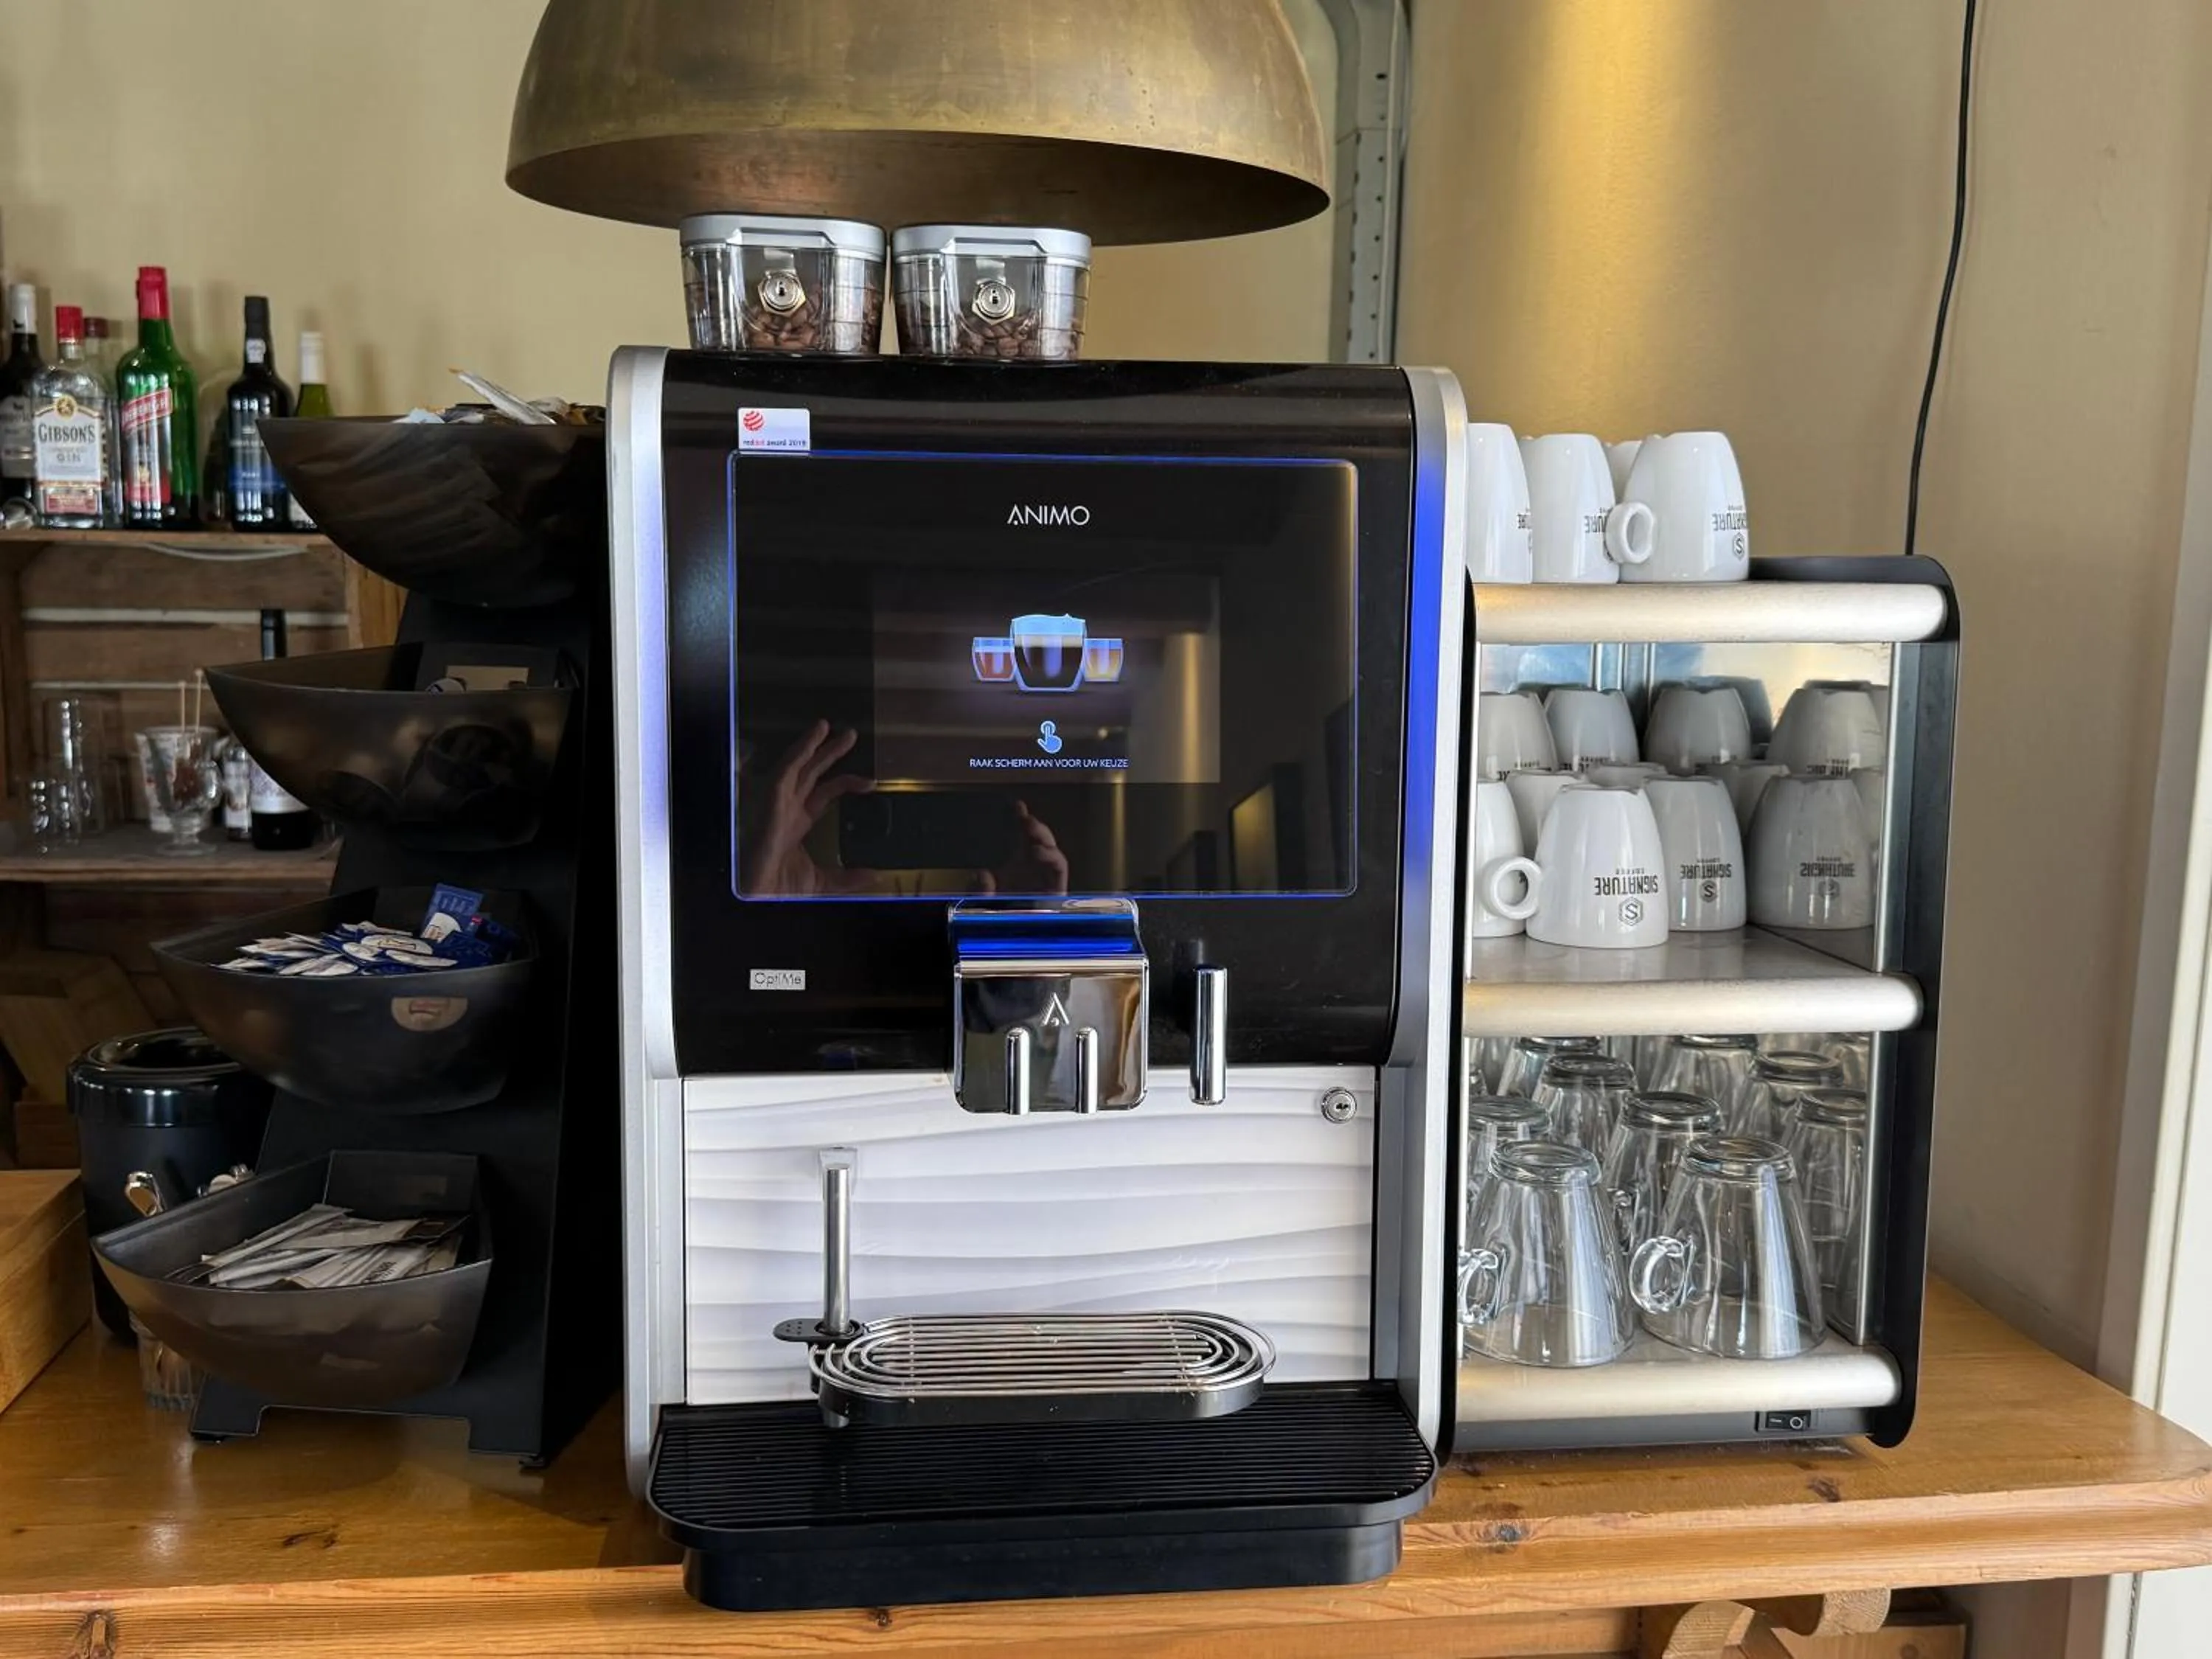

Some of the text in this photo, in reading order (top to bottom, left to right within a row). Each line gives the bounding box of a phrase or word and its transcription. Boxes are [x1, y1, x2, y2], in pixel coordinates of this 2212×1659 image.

[38, 423, 95, 443] GIBSON'S
[1007, 504, 1090, 525] ANIMO
[970, 759, 1129, 768] RAAK SCHERM AAN VOOR UW KEUZE
[1680, 863, 1732, 879] SIGNATURE
[1593, 874, 1658, 896] SIGNATURE
[755, 973, 801, 987] OptiMe
